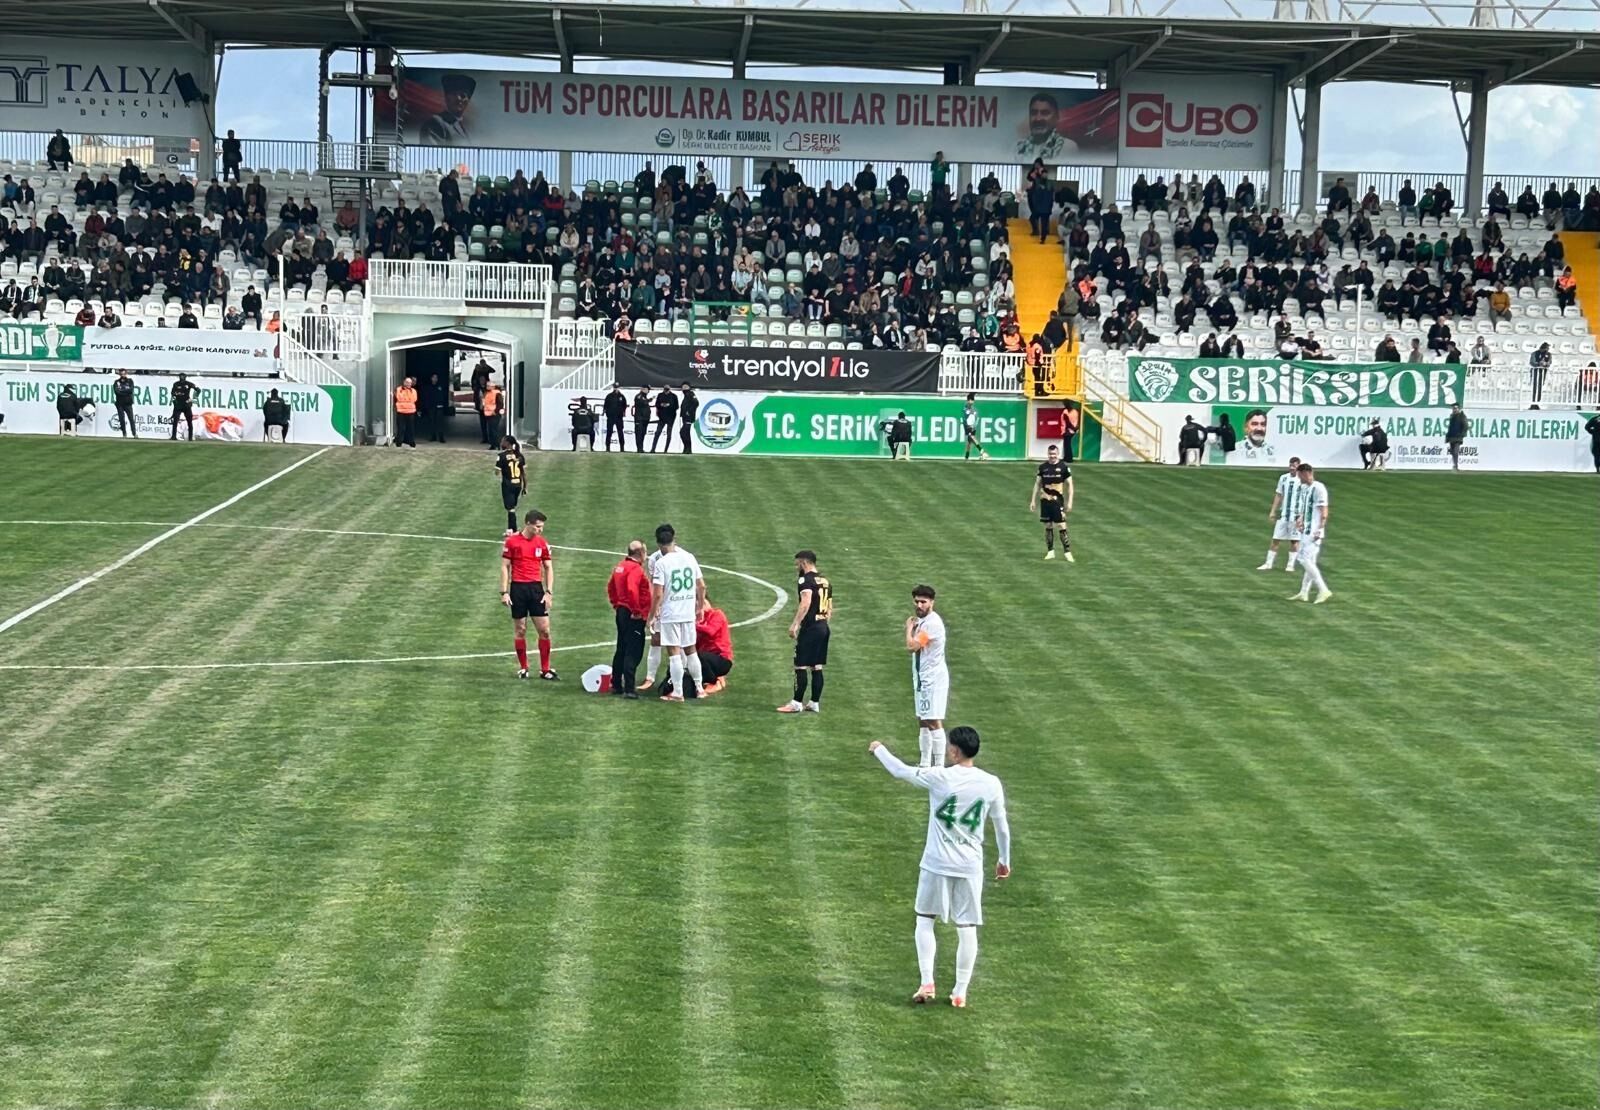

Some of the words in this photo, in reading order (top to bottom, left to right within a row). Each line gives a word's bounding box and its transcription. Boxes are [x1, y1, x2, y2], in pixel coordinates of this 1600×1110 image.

[80, 109, 169, 119] BETON
[500, 80, 553, 114] TÜM
[562, 83, 733, 121] SPORCULARA
[742, 88, 886, 126] BAŞARILAR
[896, 93, 998, 129] DİLERİM
[1128, 101, 1258, 136] CUBO
[696, 129, 707, 140] Dr.
[708, 129, 732, 141] Kadir
[736, 130, 772, 143] KUMBUL
[721, 355, 826, 381] trendyol
[6, 381, 40, 402] TÜM
[1188, 364, 1458, 407] SERİKSPOR
[763, 413, 801, 439] T.C.
[810, 414, 878, 441] SERİK
[1276, 415, 1309, 434] TÜM
[1516, 419, 1579, 440] DİLERİM
[508, 461, 521, 478] 16
[671, 567, 694, 593] 58
[934, 794, 984, 833] 44
